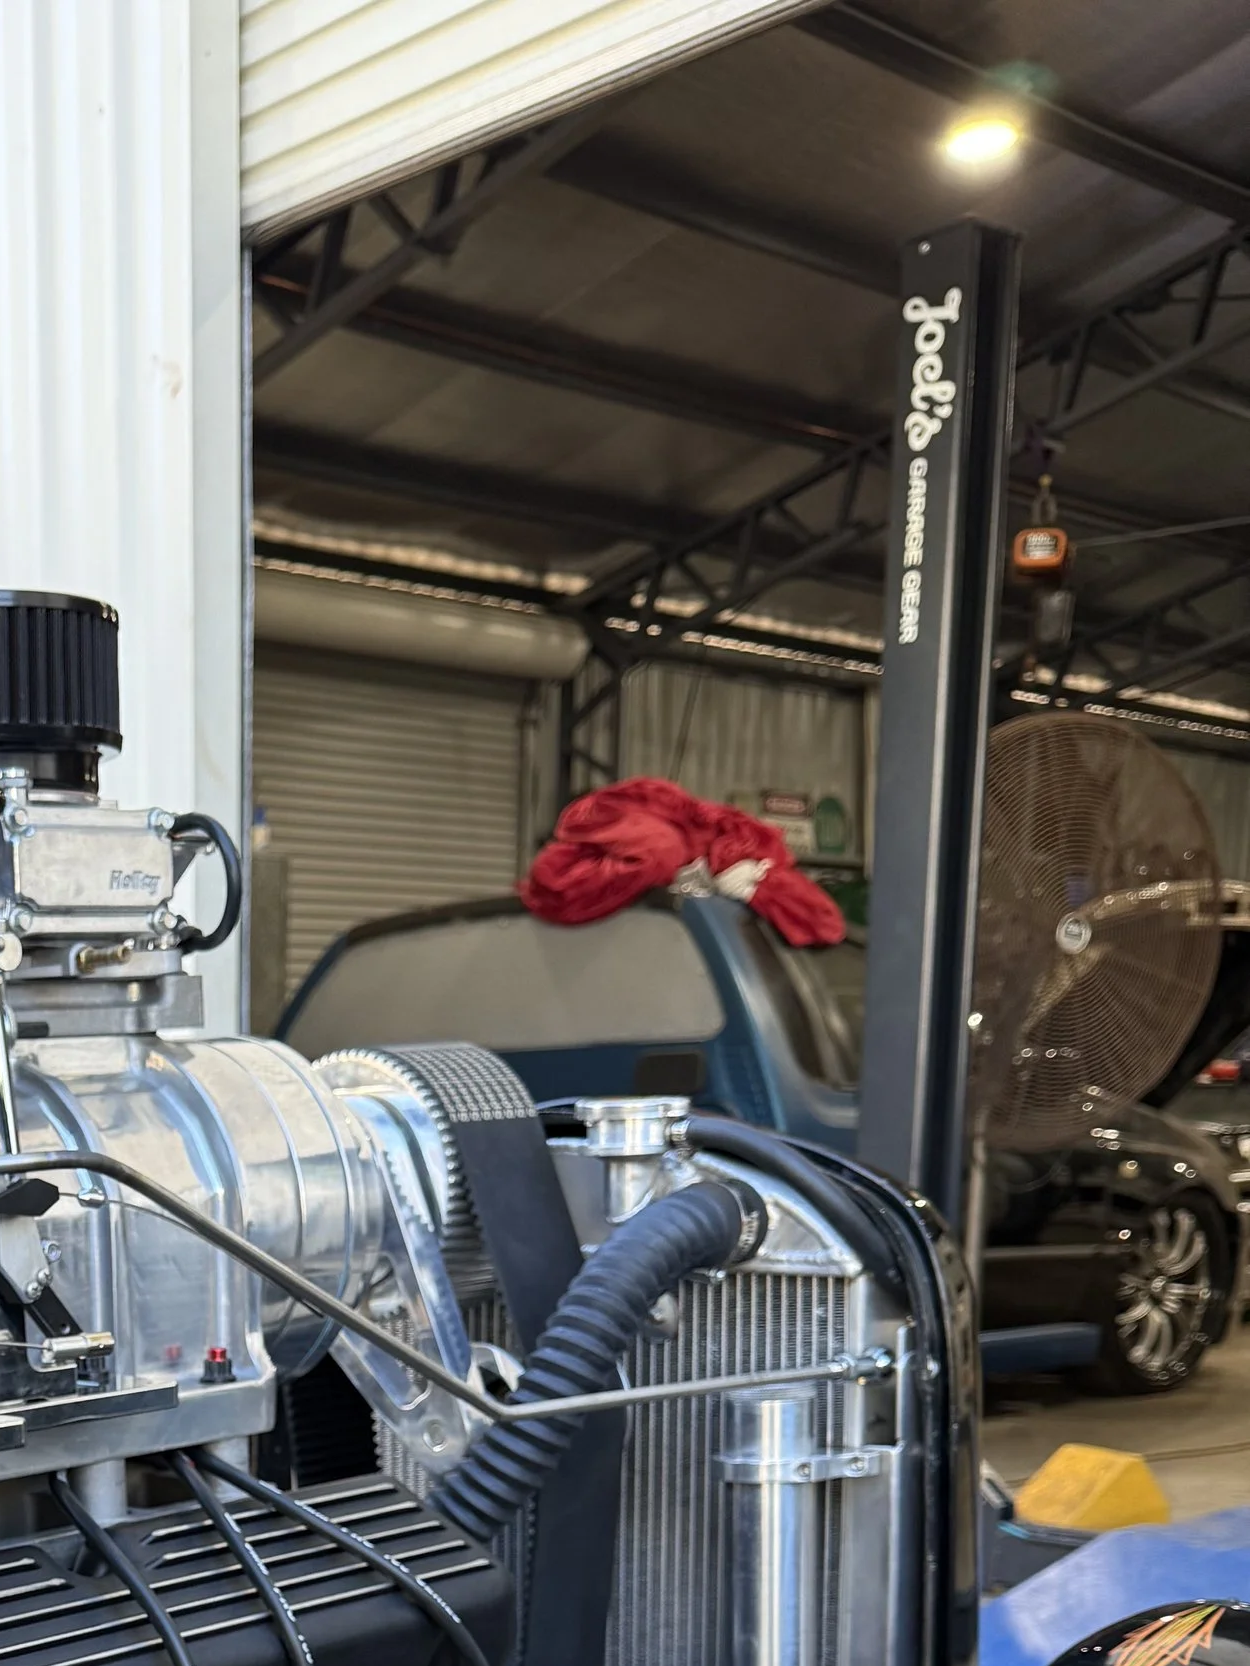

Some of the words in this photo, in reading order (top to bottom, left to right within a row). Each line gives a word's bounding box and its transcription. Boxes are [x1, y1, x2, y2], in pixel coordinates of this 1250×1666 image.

[902, 286, 962, 452] Joel's
[903, 457, 929, 568] GARAGE
[898, 569, 923, 645] GEAR
[109, 869, 161, 896] Holley
